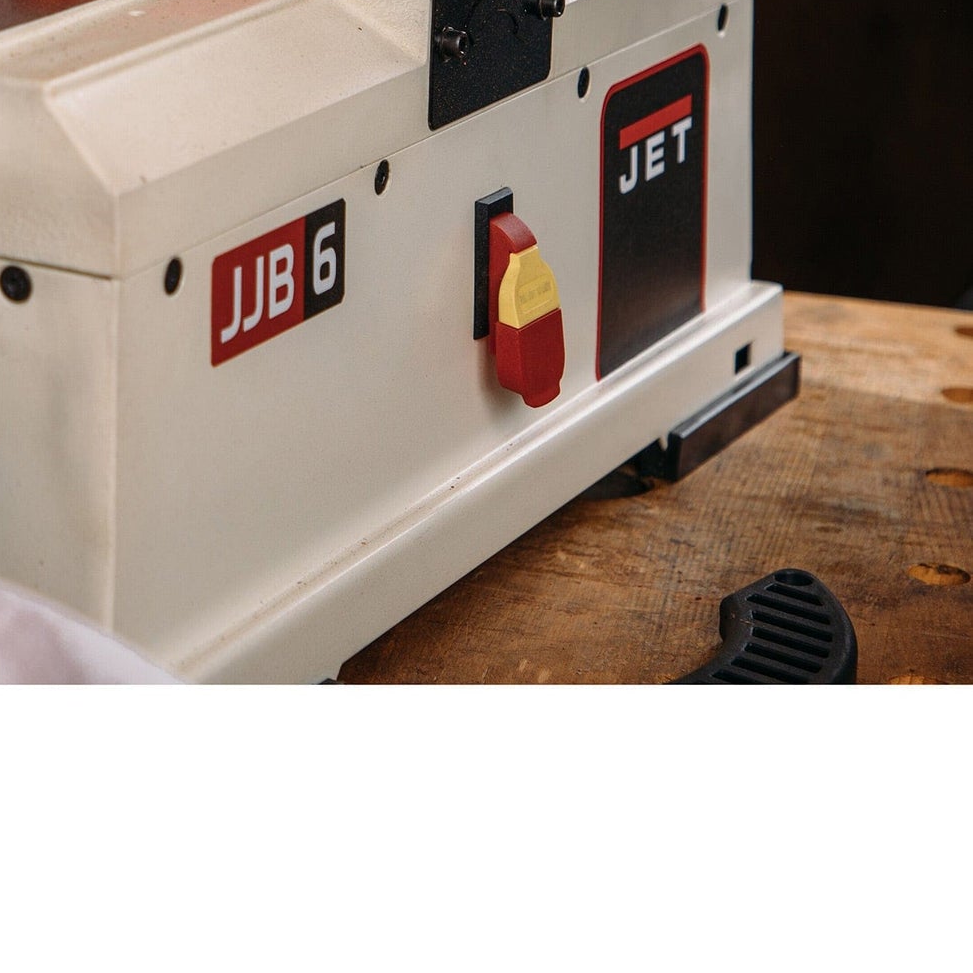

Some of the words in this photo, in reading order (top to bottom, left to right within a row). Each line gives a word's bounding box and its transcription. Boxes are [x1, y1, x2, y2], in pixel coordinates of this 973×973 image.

[619, 116, 693, 195] JET
[220, 243, 295, 344] JJB
[313, 221, 337, 296] 6
